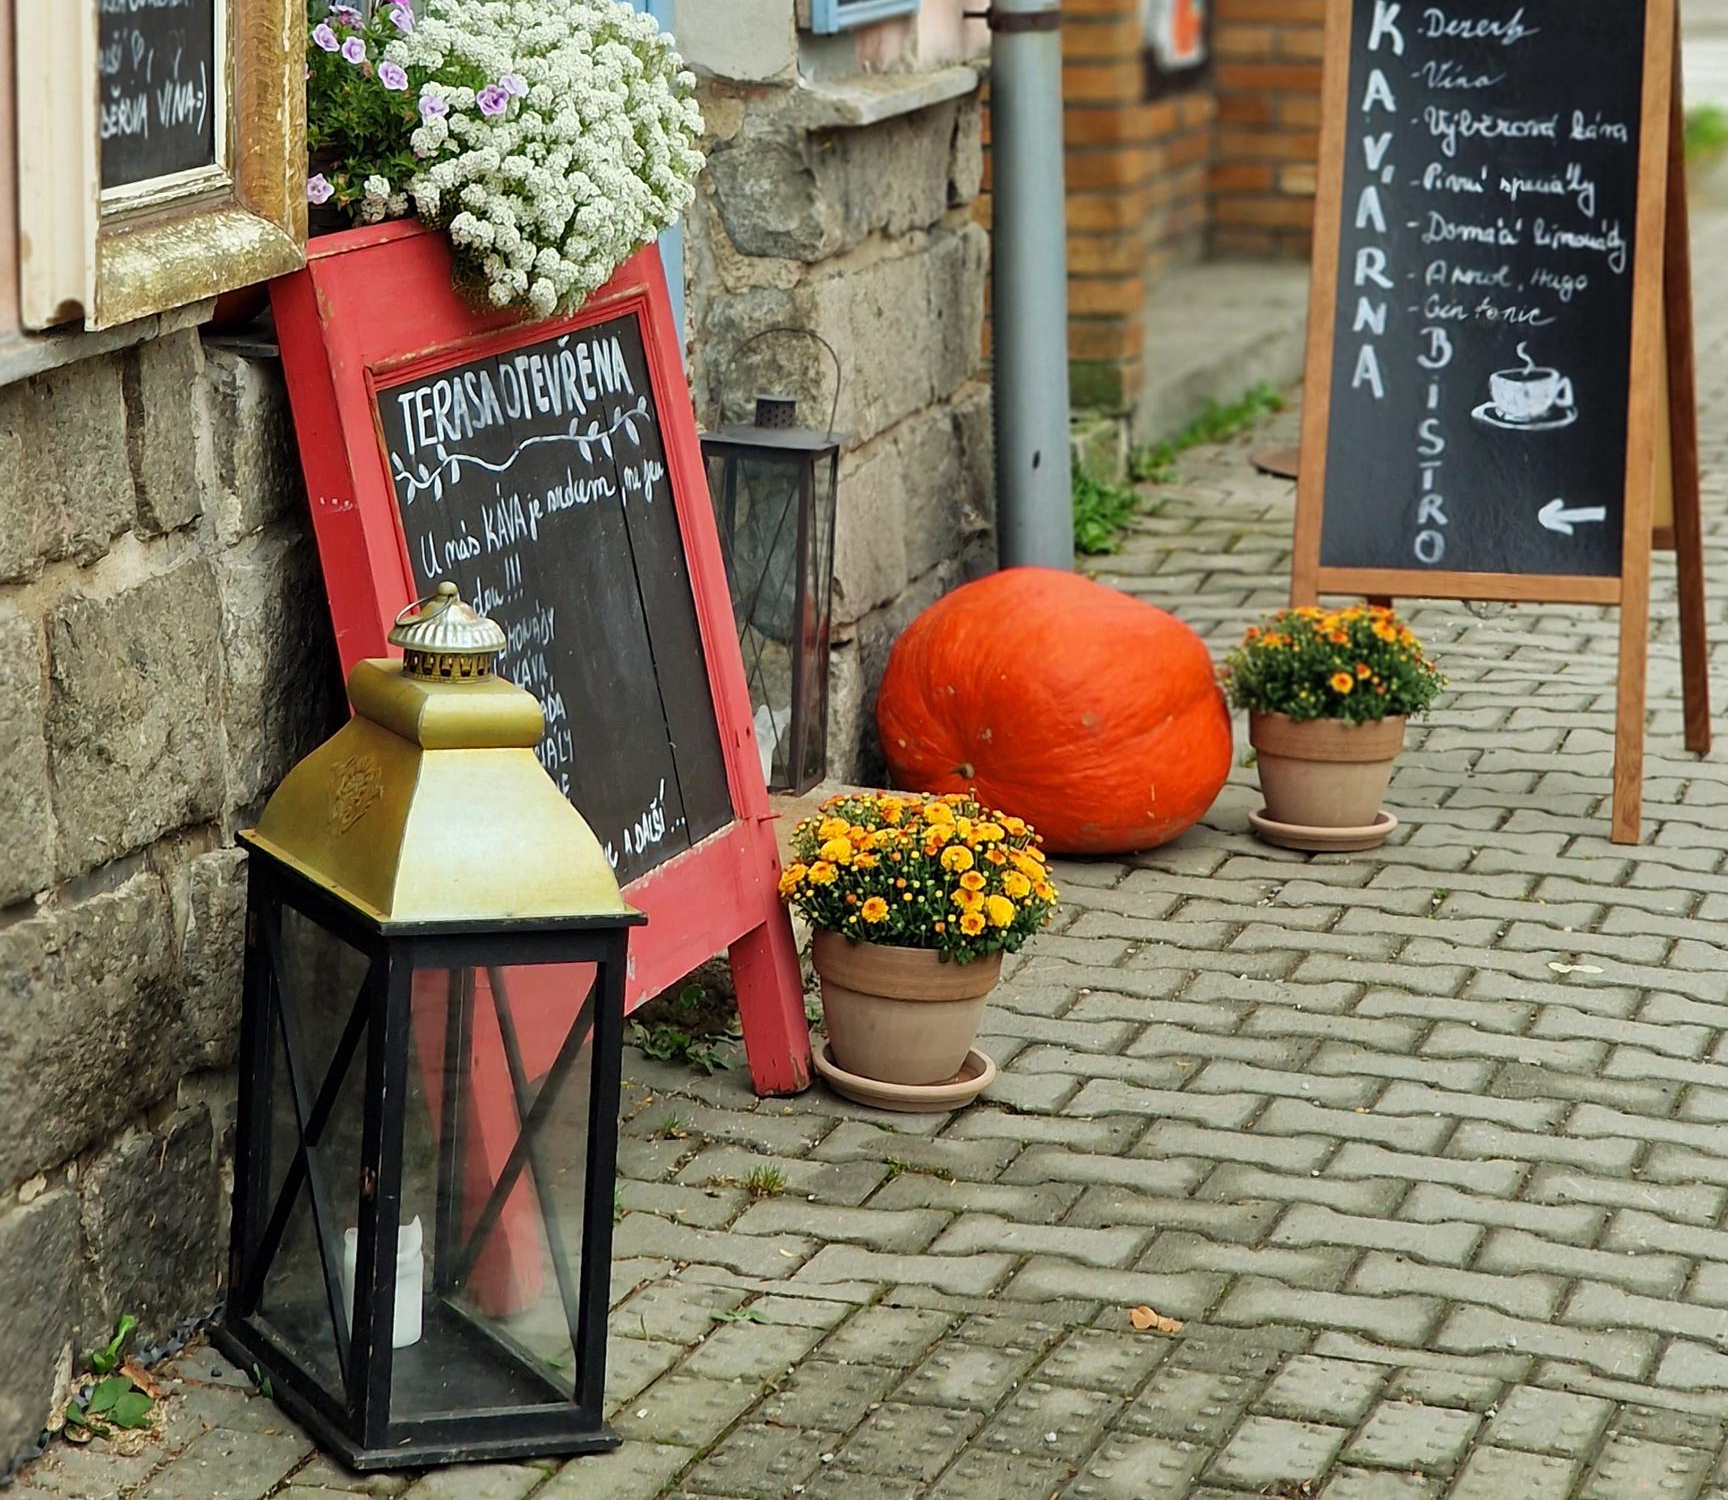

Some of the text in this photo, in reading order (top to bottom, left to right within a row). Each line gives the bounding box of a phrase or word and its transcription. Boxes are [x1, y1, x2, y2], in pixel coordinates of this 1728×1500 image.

[1529, 268, 1589, 302] Hugo
[398, 334, 635, 455] TERASA OTEVŘENA
[481, 482, 528, 553] KÁVA
